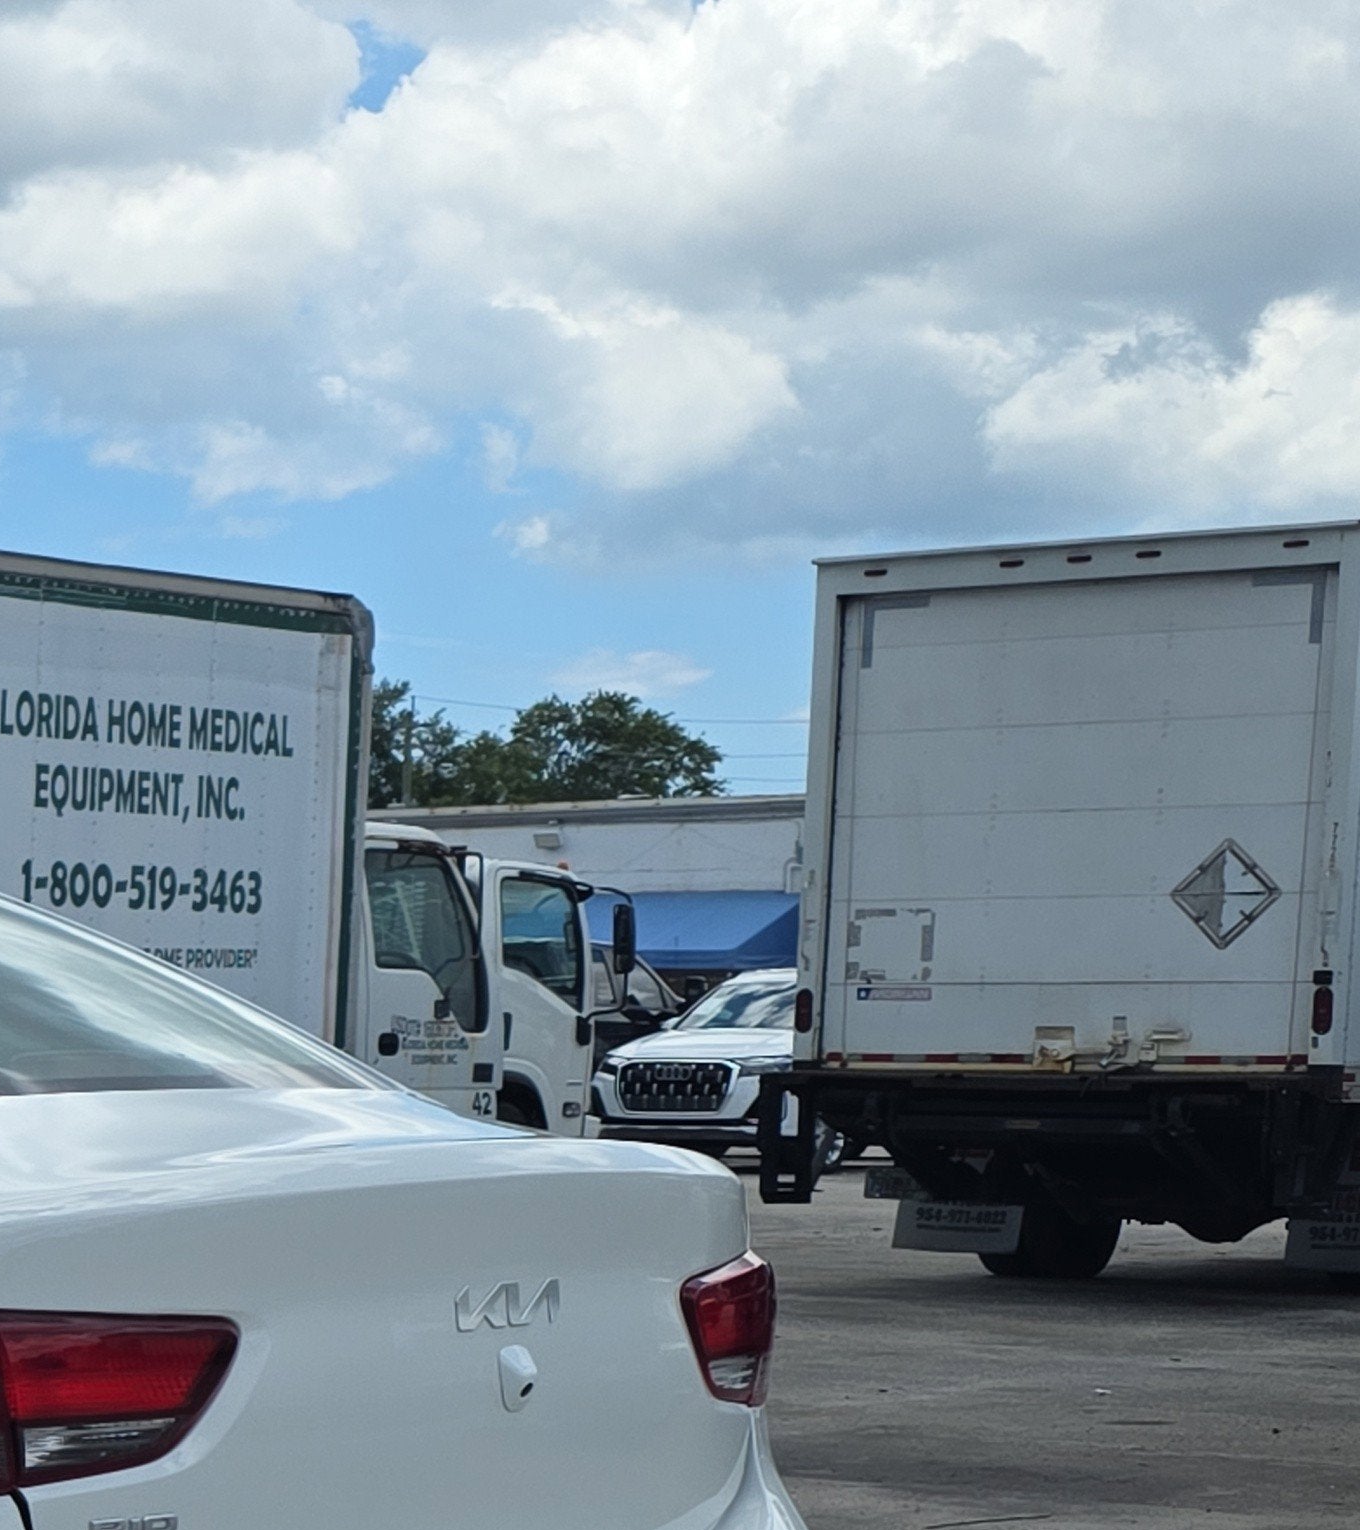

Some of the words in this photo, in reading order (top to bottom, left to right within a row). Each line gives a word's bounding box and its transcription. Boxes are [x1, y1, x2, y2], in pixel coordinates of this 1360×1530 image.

[106, 699, 182, 749] HOME
[188, 706, 294, 757] MEDICAL
[33, 763, 190, 824] EQUIPMENT,
[196, 774, 245, 821] INC.
[21, 858, 262, 915] 1-800-519-3463
[472, 1091, 493, 1116] 42
